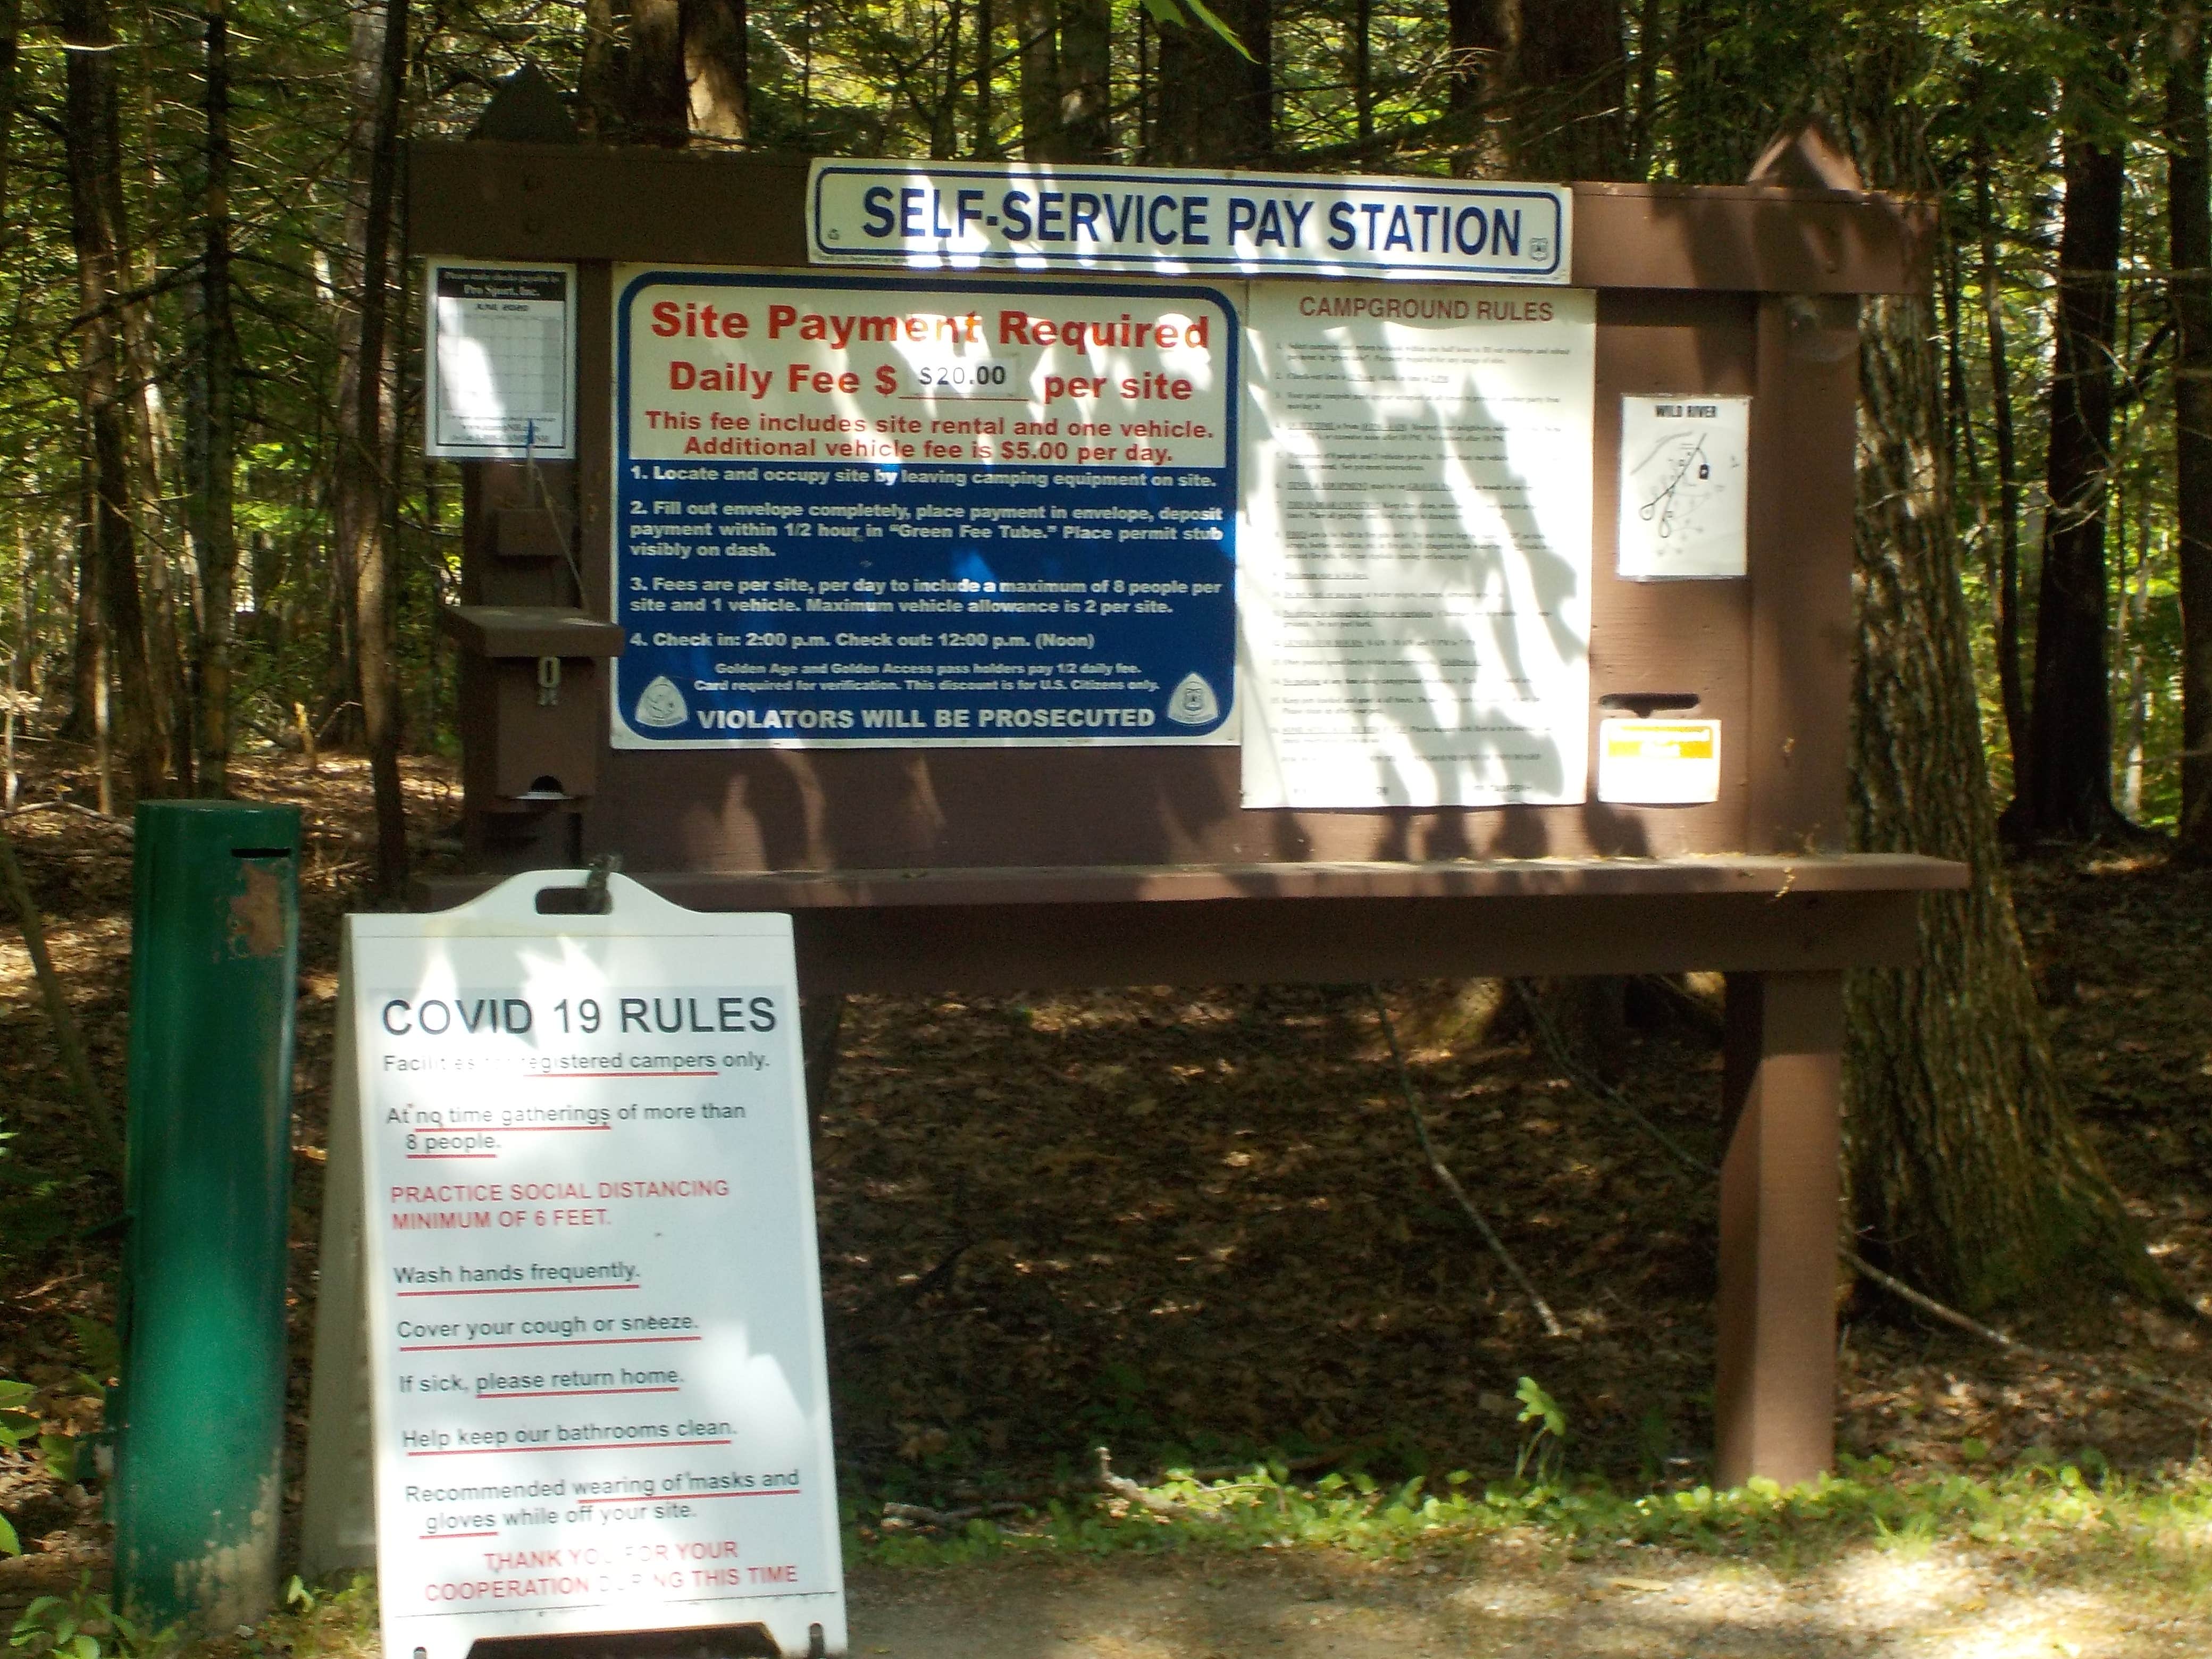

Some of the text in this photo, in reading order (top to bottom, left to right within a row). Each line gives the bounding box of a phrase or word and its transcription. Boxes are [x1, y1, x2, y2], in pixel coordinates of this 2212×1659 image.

[862, 186, 1520, 256] SELF-SERVICE PAY STATION
[1300, 296, 1554, 321] CAMPGROUND RULES
[652, 301, 1209, 355] Site Payment Required
[669, 361, 1193, 404] Daily Fee $ $20.00 per site
[646, 410, 1213, 439] This fee includes site rental and one vehicle.
[684, 436, 1172, 465] Additional vehicle fee is $5.00 per day.
[652, 466, 719, 481] Locate
[724, 467, 758, 481] and
[763, 470, 828, 484] occupy
[834, 469, 870, 483] site
[874, 469, 898, 485] by
[901, 469, 967, 487] leaving
[971, 471, 1050, 488] camping
[1053, 472, 1147, 488] equipment
[652, 501, 682, 515] Fill
[686, 502, 718, 515] out
[722, 502, 803, 519] envelope
[915, 504, 965, 521] place
[969, 506, 1046, 521] payment
[1050, 505, 1068, 520] in
[1158, 507, 1223, 522] deposit
[629, 523, 713, 538] payment
[718, 523, 778, 537] within
[817, 524, 859, 537] hour
[959, 524, 993, 539] Fee
[1062, 525, 1113, 540] Place
[1118, 525, 1178, 542] permit
[1182, 526, 1224, 540] stub
[629, 543, 691, 559] visibly
[652, 577, 698, 591] Fees
[737, 581, 770, 594] per
[818, 581, 849, 595] per
[851, 579, 886, 595] day
[913, 579, 981, 593] include
[999, 580, 1087, 593] maximum
[1128, 580, 1187, 597] people
[1191, 583, 1222, 597] per
[629, 598, 667, 611] site
[670, 598, 707, 612] and
[806, 598, 894, 613] Maximum
[898, 599, 963, 613] vehicle
[967, 599, 1060, 613] allowance
[1100, 603, 1130, 616] per
[652, 632, 713, 647] Check
[745, 633, 787, 647] 2:00
[834, 633, 891, 647] Check
[939, 633, 988, 647] 12:00
[1035, 633, 1095, 650] (Noon)
[697, 708, 1155, 728] VIOLATORS WILL BE PROSECUTED
[383, 996, 776, 1034] COVID 19 RULES
[630, 1054, 716, 1073] campers
[723, 1051, 770, 1071] only.
[386, 1106, 409, 1125] At
[449, 1107, 492, 1123] time
[501, 1105, 610, 1126] gatherings
[618, 1104, 638, 1121] of
[643, 1106, 696, 1120] more
[701, 1102, 745, 1120] than
[407, 1133, 501, 1154] 8 people.
[391, 1179, 730, 1204] PRACTICE SOCIAL DISTANCING
[392, 1208, 612, 1230] MINIMUM OF 6 FEET.
[395, 1261, 640, 1284] Wash hands frequently.
[397, 1315, 699, 1340] Cover your cough or sneeze.
[400, 1375, 416, 1393] If
[476, 1371, 545, 1393] please
[551, 1370, 615, 1387] return
[621, 1368, 684, 1385] home.
[403, 1419, 736, 1450] Help keep our bathrooms clean.
[407, 1469, 799, 1503] Recommended wearing of masks and
[426, 1503, 697, 1534] gloves while off your site.
[483, 1551, 562, 1571] THANK
[675, 1541, 739, 1561] YOUR
[425, 1565, 797, 1602] COOPERATION THIS TIME
